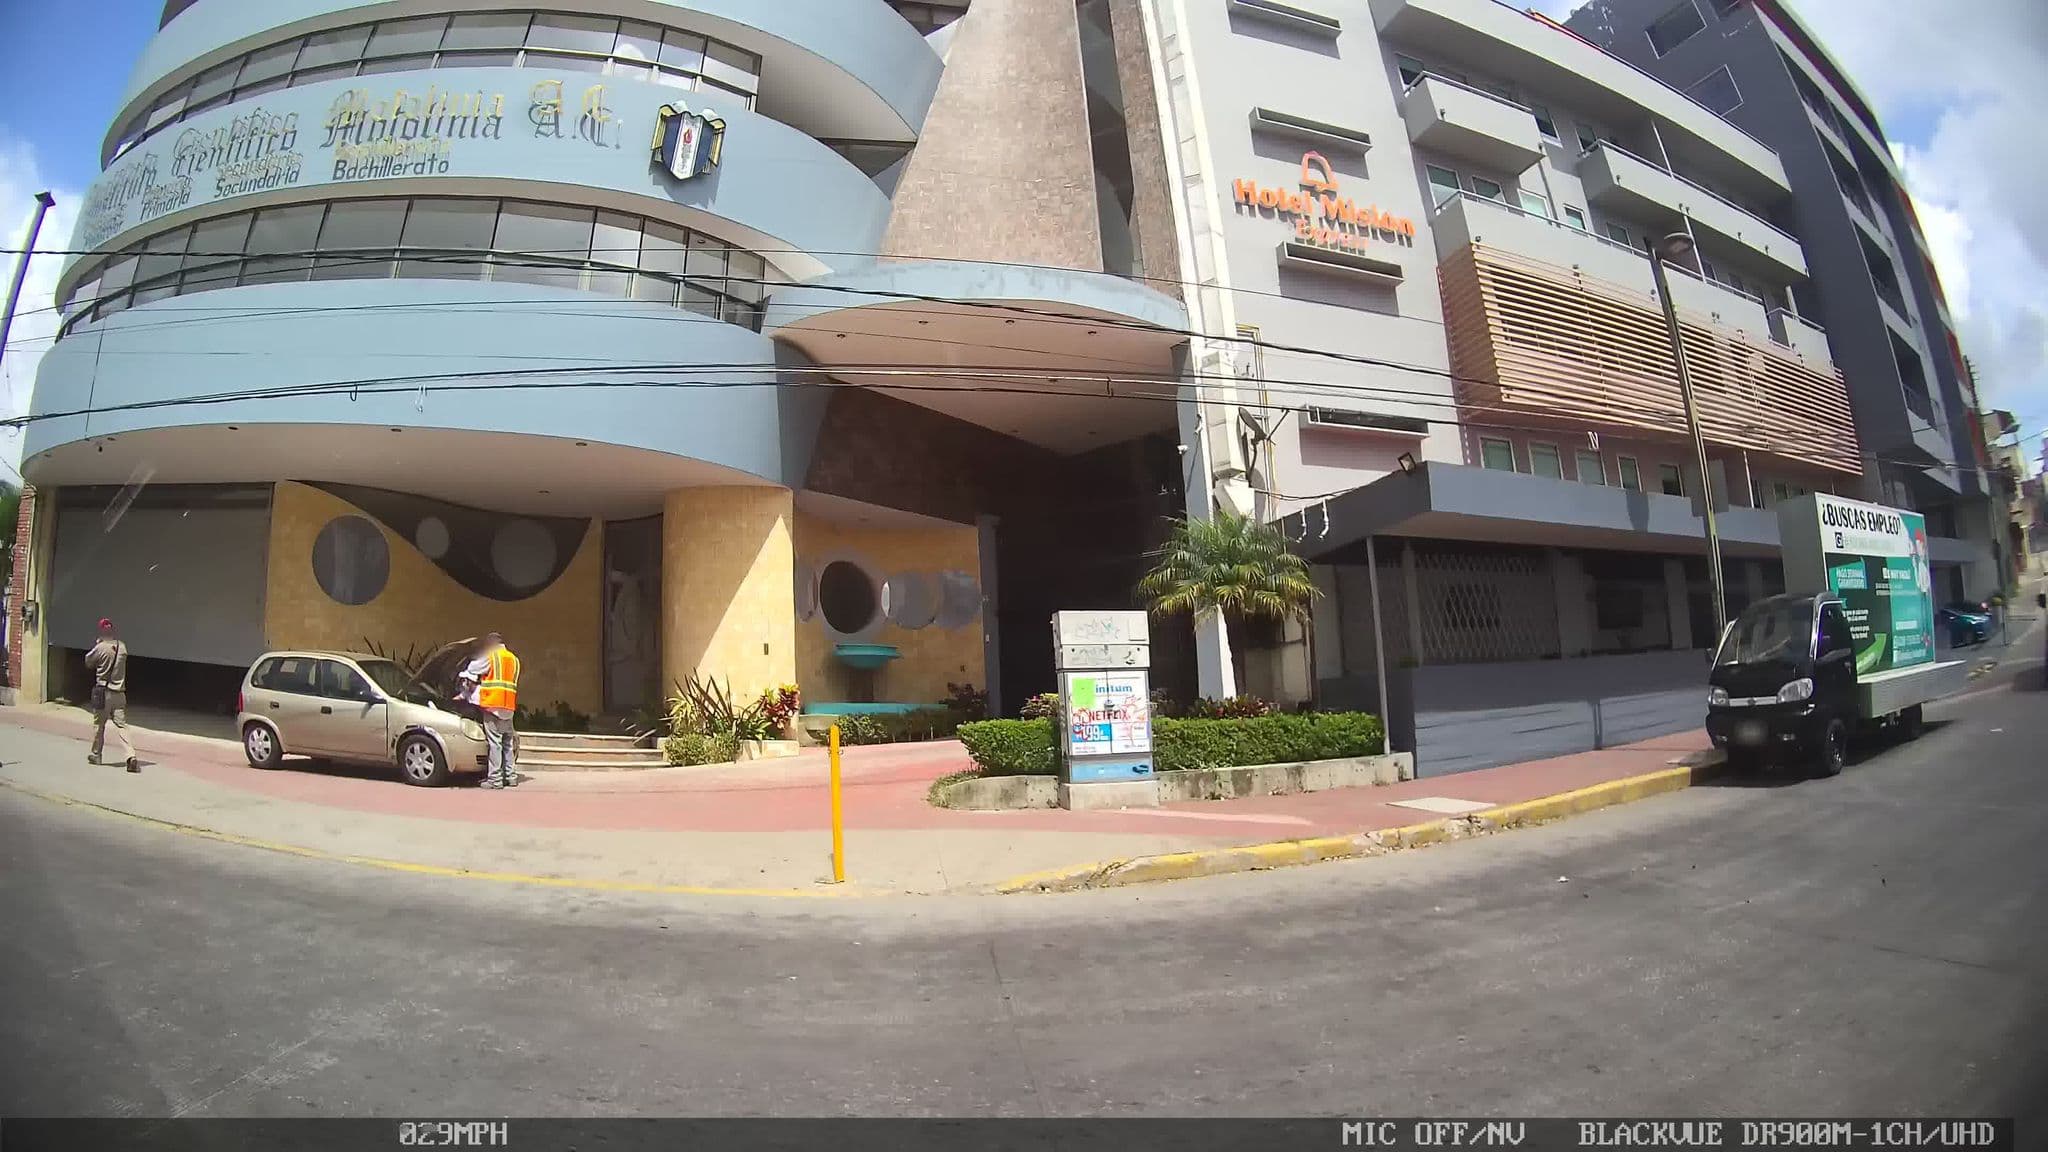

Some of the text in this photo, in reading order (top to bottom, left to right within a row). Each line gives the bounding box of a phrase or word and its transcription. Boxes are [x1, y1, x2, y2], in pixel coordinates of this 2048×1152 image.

[213, 153, 303, 198] Secundaria
[332, 147, 450, 180] Bachillerato
[1233, 178, 1312, 217] Hotel
[1822, 504, 1867, 531] ¿BUSCAS
[1089, 709, 1128, 721] NETFLIX
